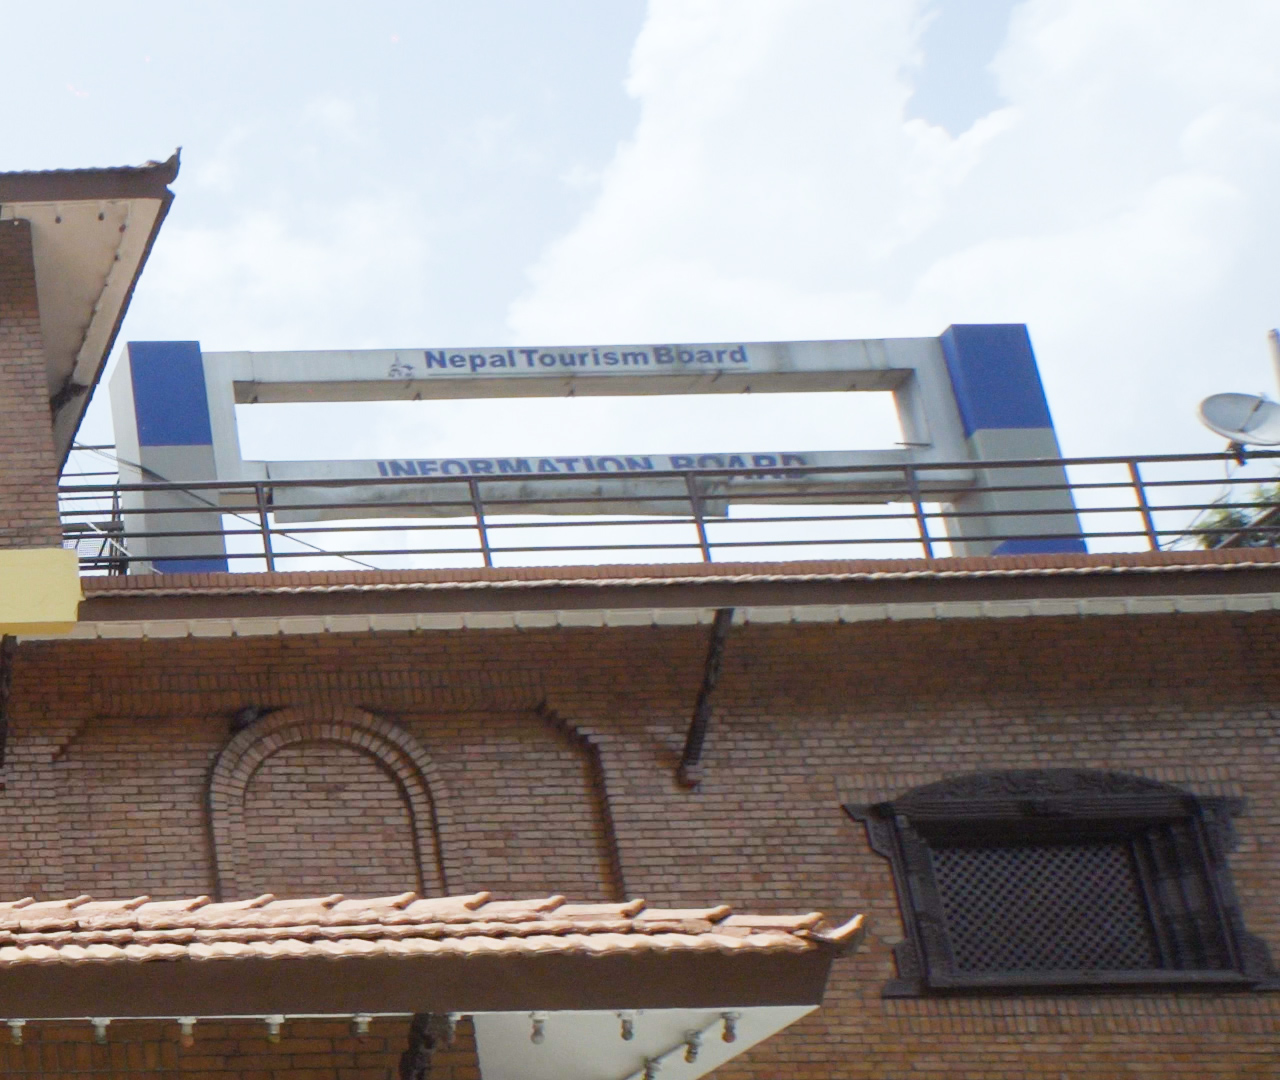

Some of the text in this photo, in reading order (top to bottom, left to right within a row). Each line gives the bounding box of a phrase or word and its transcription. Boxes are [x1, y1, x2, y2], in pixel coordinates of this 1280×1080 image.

[424, 345, 749, 372] Nepal Tourism Board
[376, 456, 654, 477] INFORMATION
